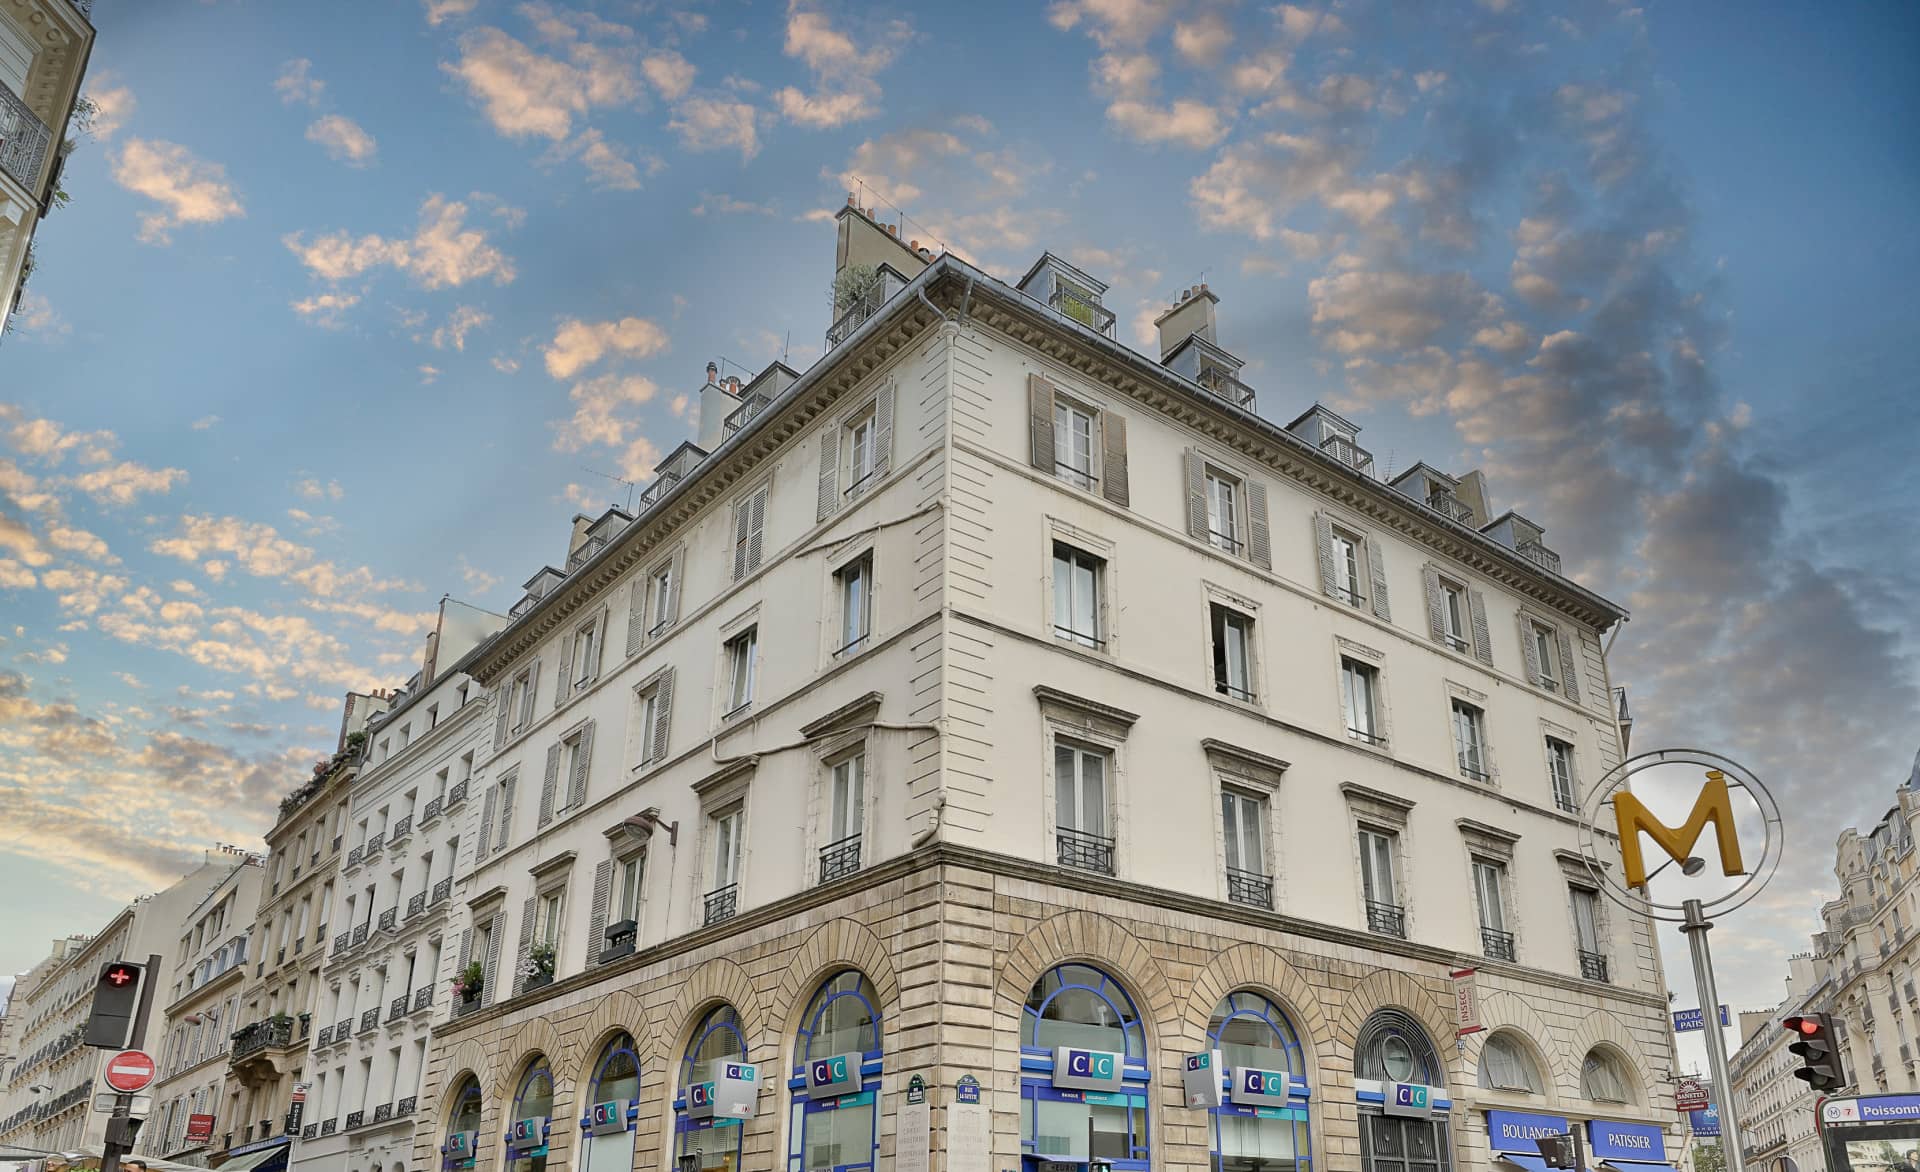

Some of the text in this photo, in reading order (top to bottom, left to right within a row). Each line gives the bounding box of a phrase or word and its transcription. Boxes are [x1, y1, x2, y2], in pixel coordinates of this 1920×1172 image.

[1613, 770, 1744, 889] M
[1459, 987, 1468, 1022] INSECC
[1676, 1008, 1725, 1020] BOULAR
[1073, 1056, 1110, 1075] CIC
[1188, 1056, 1208, 1069] CIC
[729, 1067, 753, 1079] CIC
[816, 1061, 844, 1081] CIC
[1248, 1074, 1278, 1092] CIC
[1399, 1088, 1424, 1104] CIC
[596, 1106, 615, 1122] CIC
[517, 1123, 532, 1137] CIC
[450, 1136, 464, 1149] CIC
[1608, 1133, 1651, 1149] PATISSIER
